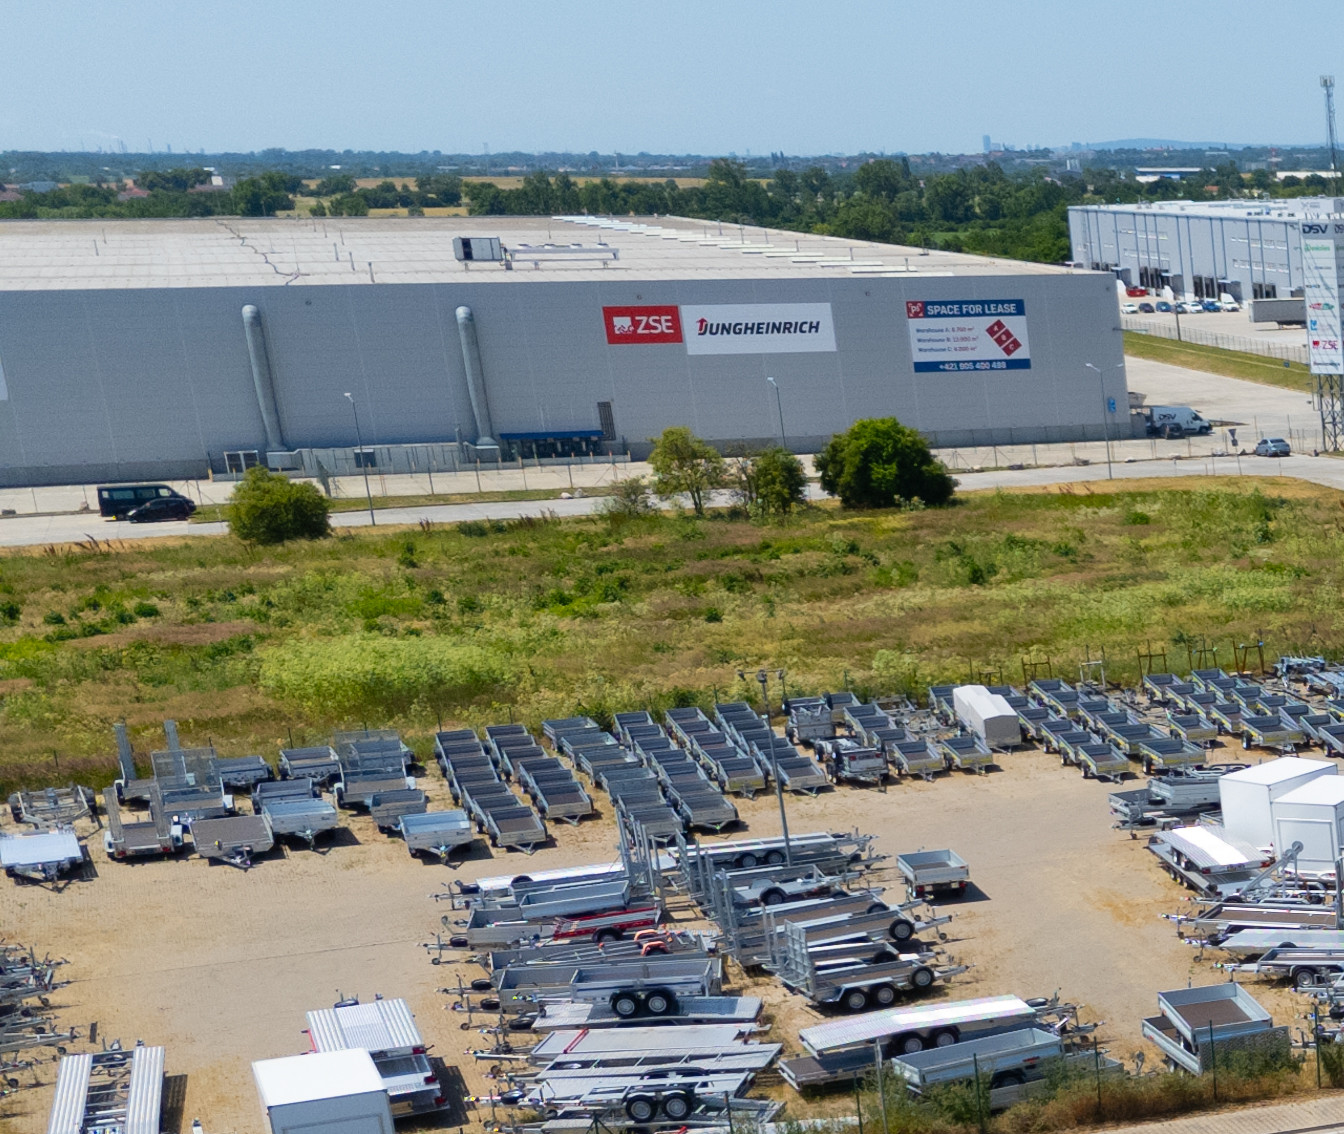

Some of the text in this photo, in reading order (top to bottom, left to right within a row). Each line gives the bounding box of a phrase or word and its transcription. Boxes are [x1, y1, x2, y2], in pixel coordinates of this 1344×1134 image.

[1302, 224, 1328, 234] DSV
[927, 303, 1017, 315] SPACE FOR LEASE
[635, 315, 674, 334] ZSE
[696, 317, 820, 336] JUNGHEINRICH
[1321, 340, 1338, 350] ZSE
